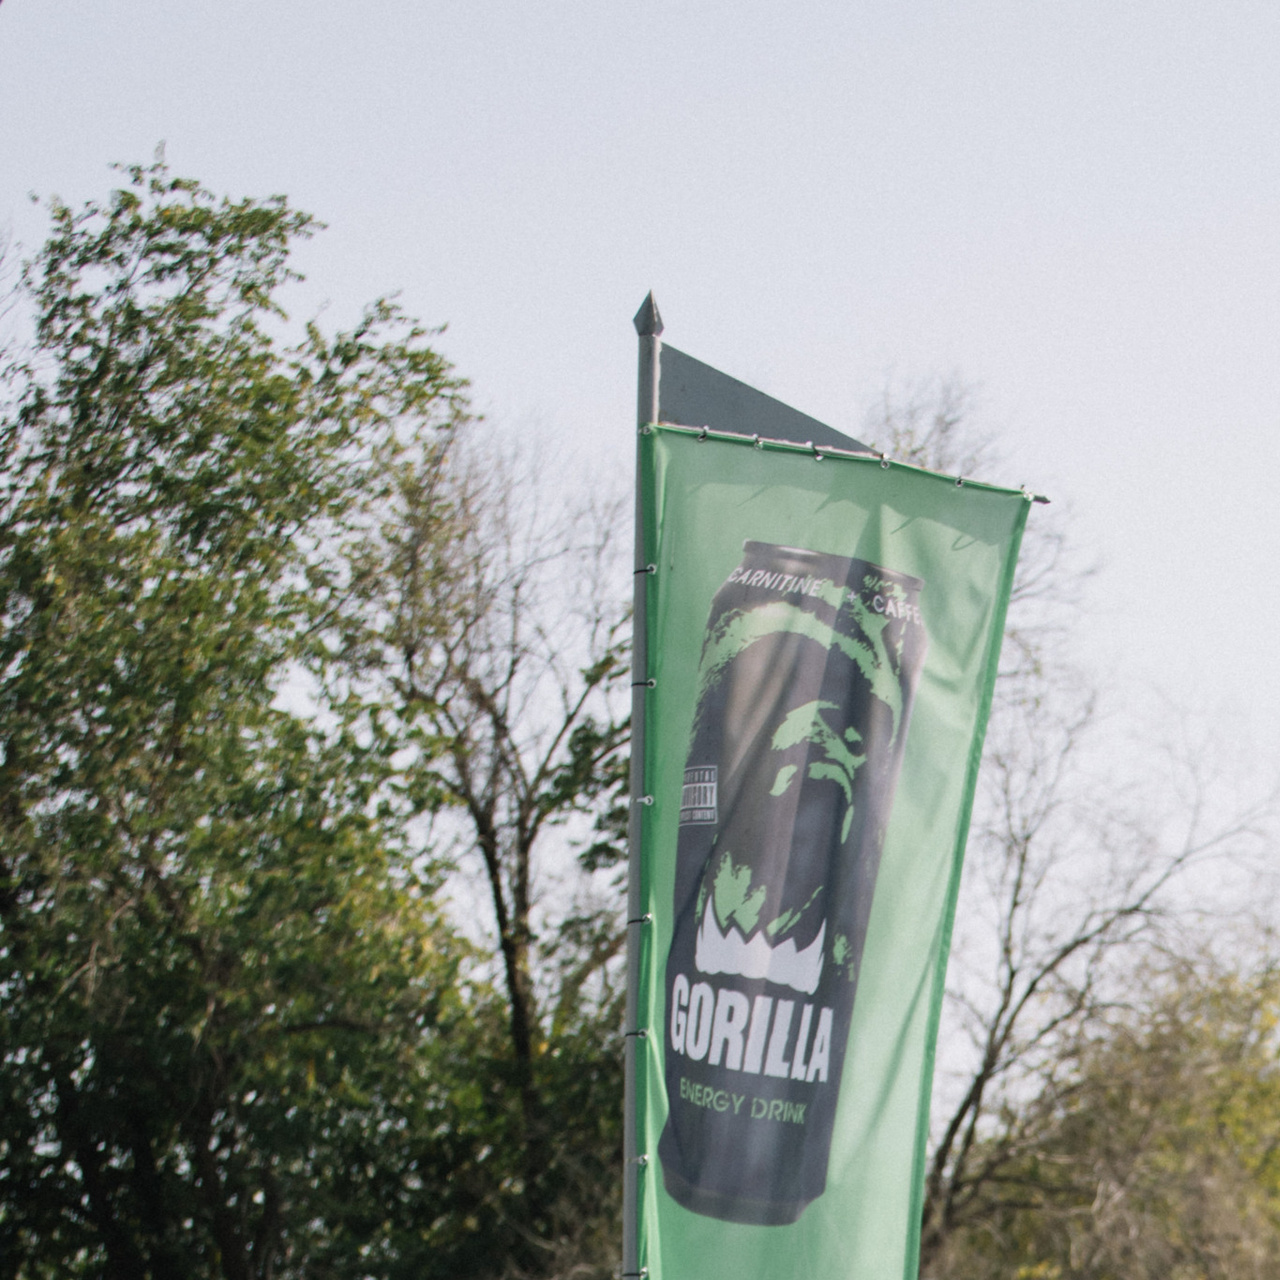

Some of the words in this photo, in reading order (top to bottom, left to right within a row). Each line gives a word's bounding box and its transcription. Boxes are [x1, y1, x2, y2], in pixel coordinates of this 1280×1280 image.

[727, 566, 822, 597] CARNITINE
[670, 973, 834, 1084] GORILLA
[679, 1076, 746, 1115] ENERGY
[750, 1097, 808, 1124] DRINK
